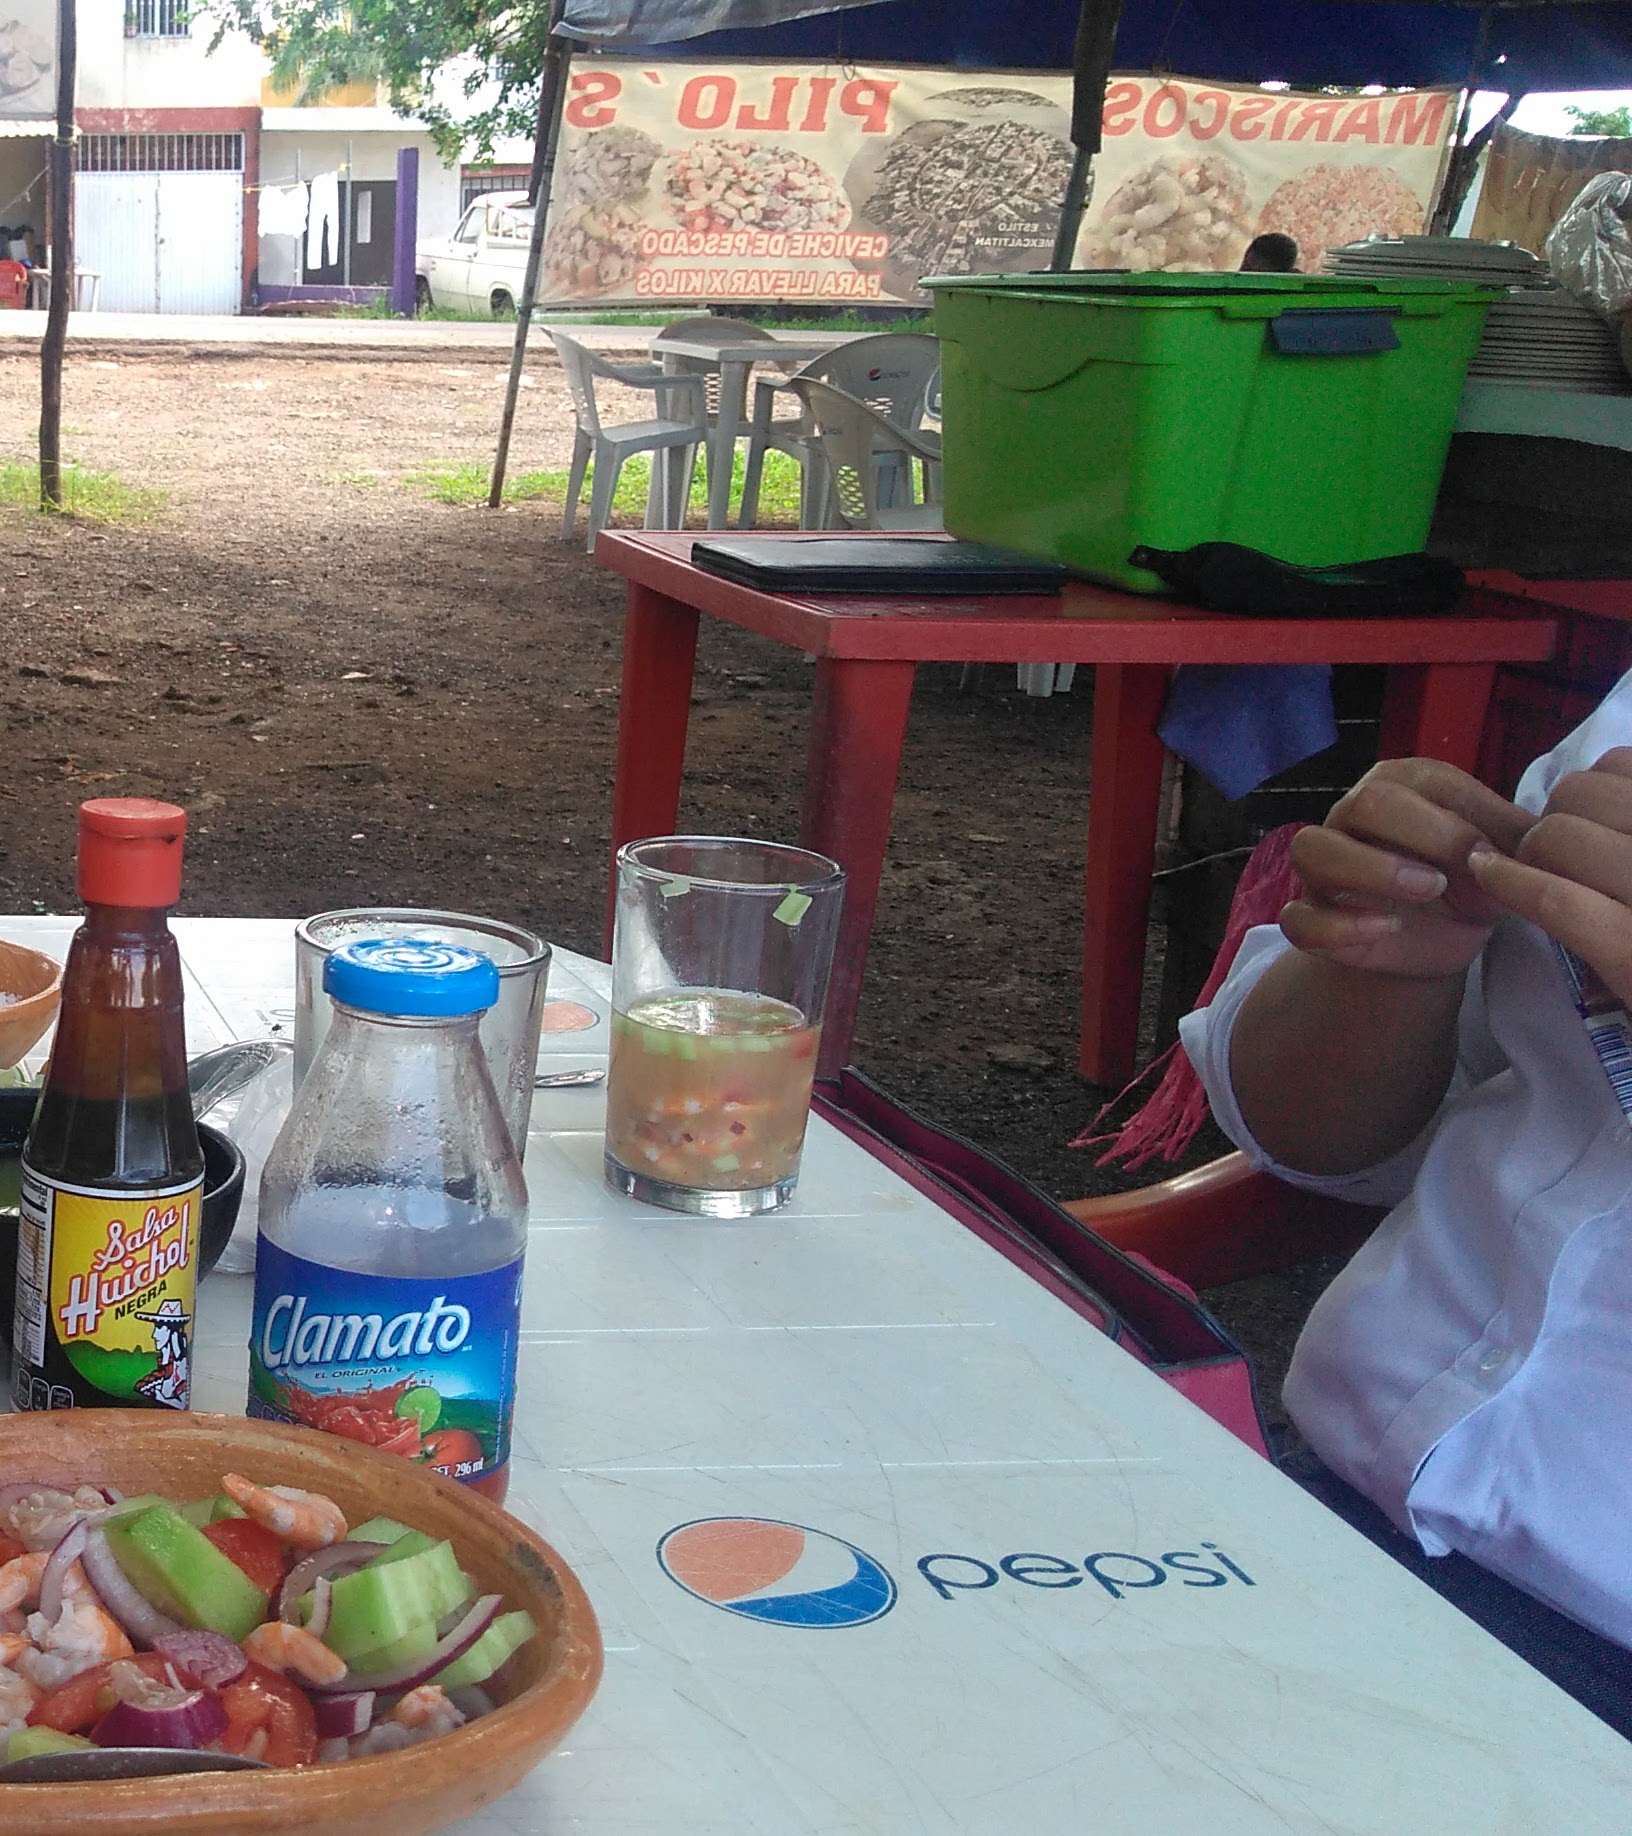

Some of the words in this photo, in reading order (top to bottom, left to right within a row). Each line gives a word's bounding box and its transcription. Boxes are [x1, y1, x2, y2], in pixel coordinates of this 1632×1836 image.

[92, 1208, 178, 1271] Salsa
[60, 1202, 190, 1336] Huichol
[115, 1279, 167, 1320] NEGRA
[261, 1295, 471, 1368] Clamato
[332, 1366, 394, 1378] ORIGINAL
[453, 1461, 473, 1478] 296
[472, 1456, 484, 1473] ml
[917, 1542, 1257, 1600] pepsi
